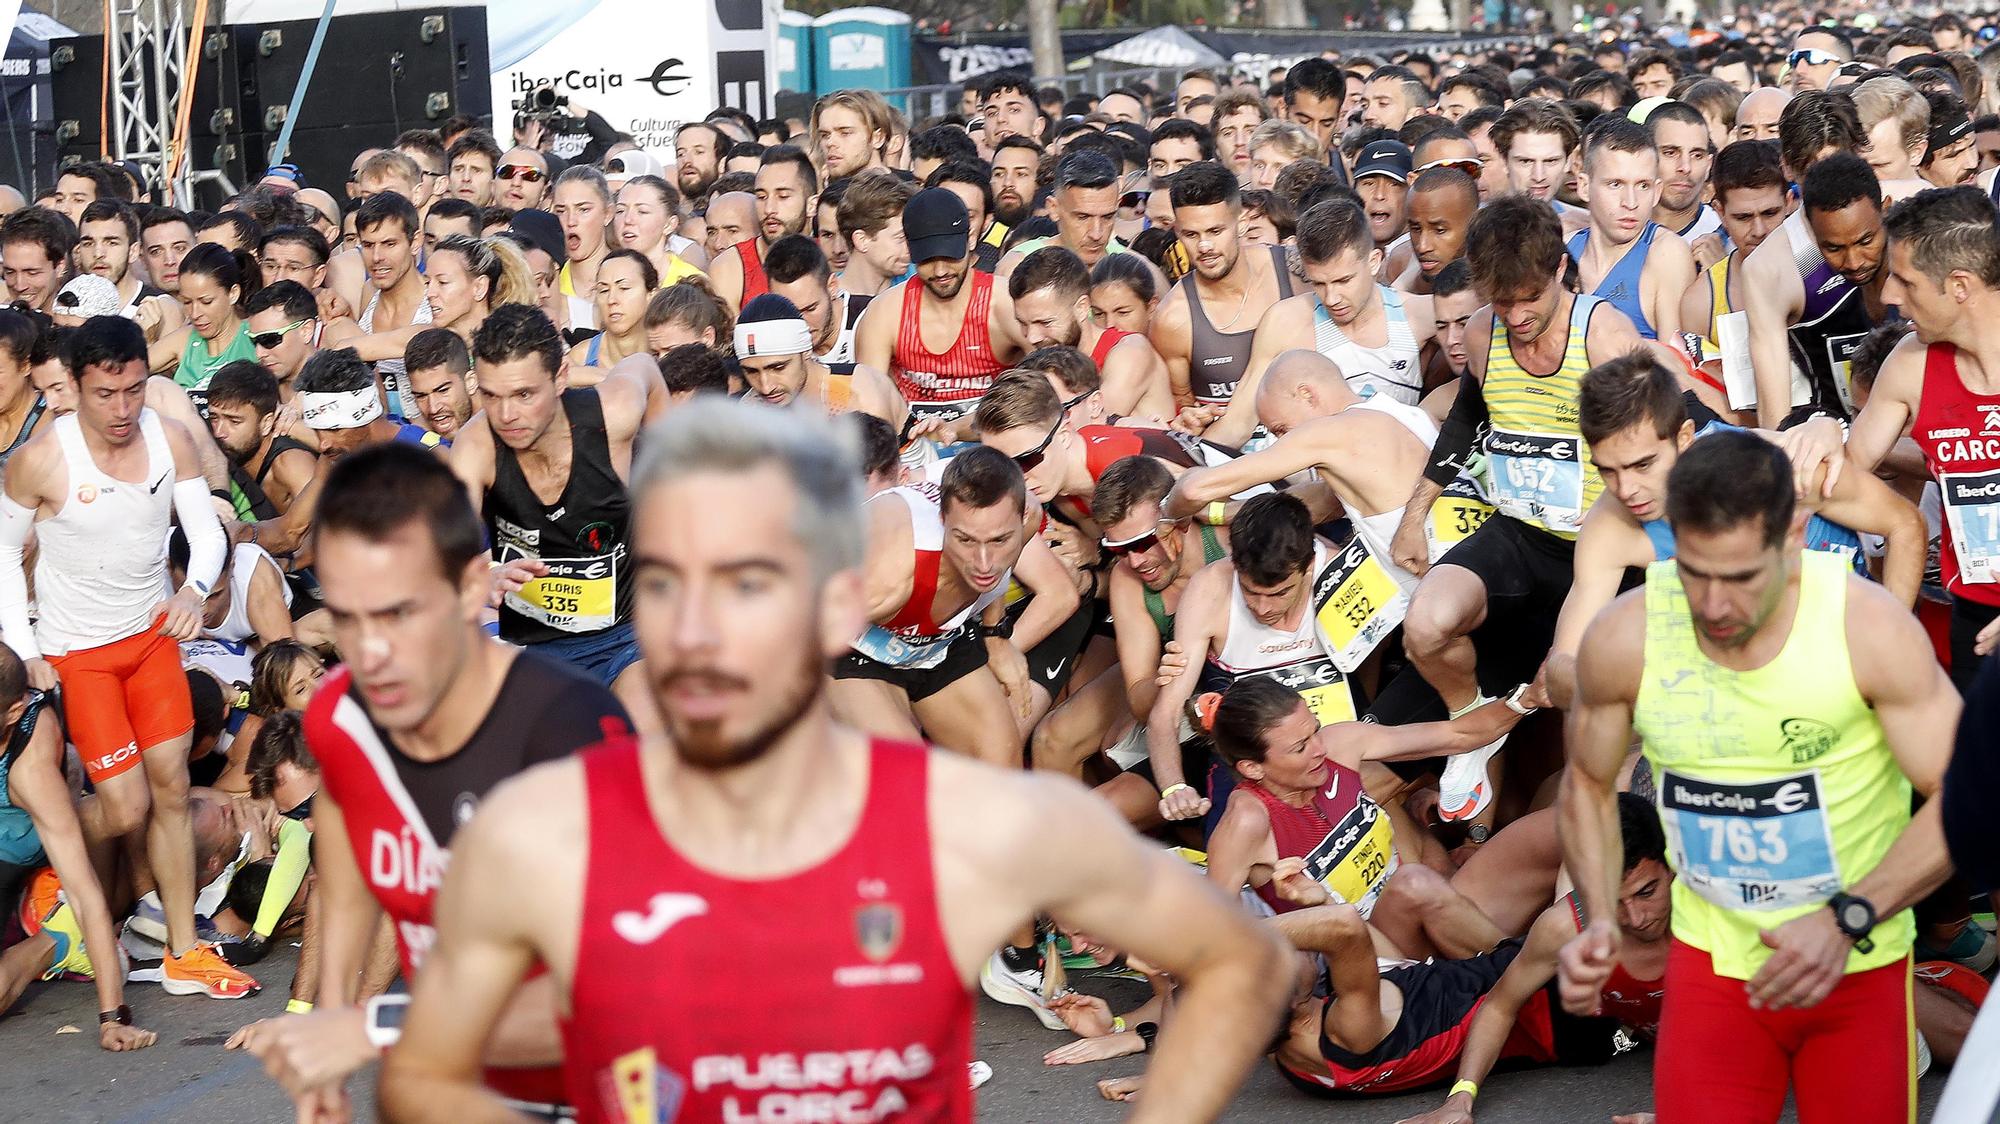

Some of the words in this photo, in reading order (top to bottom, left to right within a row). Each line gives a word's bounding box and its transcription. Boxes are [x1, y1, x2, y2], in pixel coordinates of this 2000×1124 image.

[511, 68, 623, 94] iberCaja
[1928, 427, 1971, 440] LOREDO
[1505, 457, 1555, 493] 652
[541, 583, 583, 595] FLORIS
[543, 595, 579, 613] 335
[1345, 596, 1375, 629] 332
[1257, 640, 1316, 654] saucony
[1674, 784, 1756, 812] iberCaja
[1314, 825, 1361, 870] iberCaja
[1698, 818, 1789, 864] 763
[1361, 852, 1385, 887] 220
[692, 1045, 935, 1091] PUERTAS
[721, 1086, 908, 1124] LORCA
